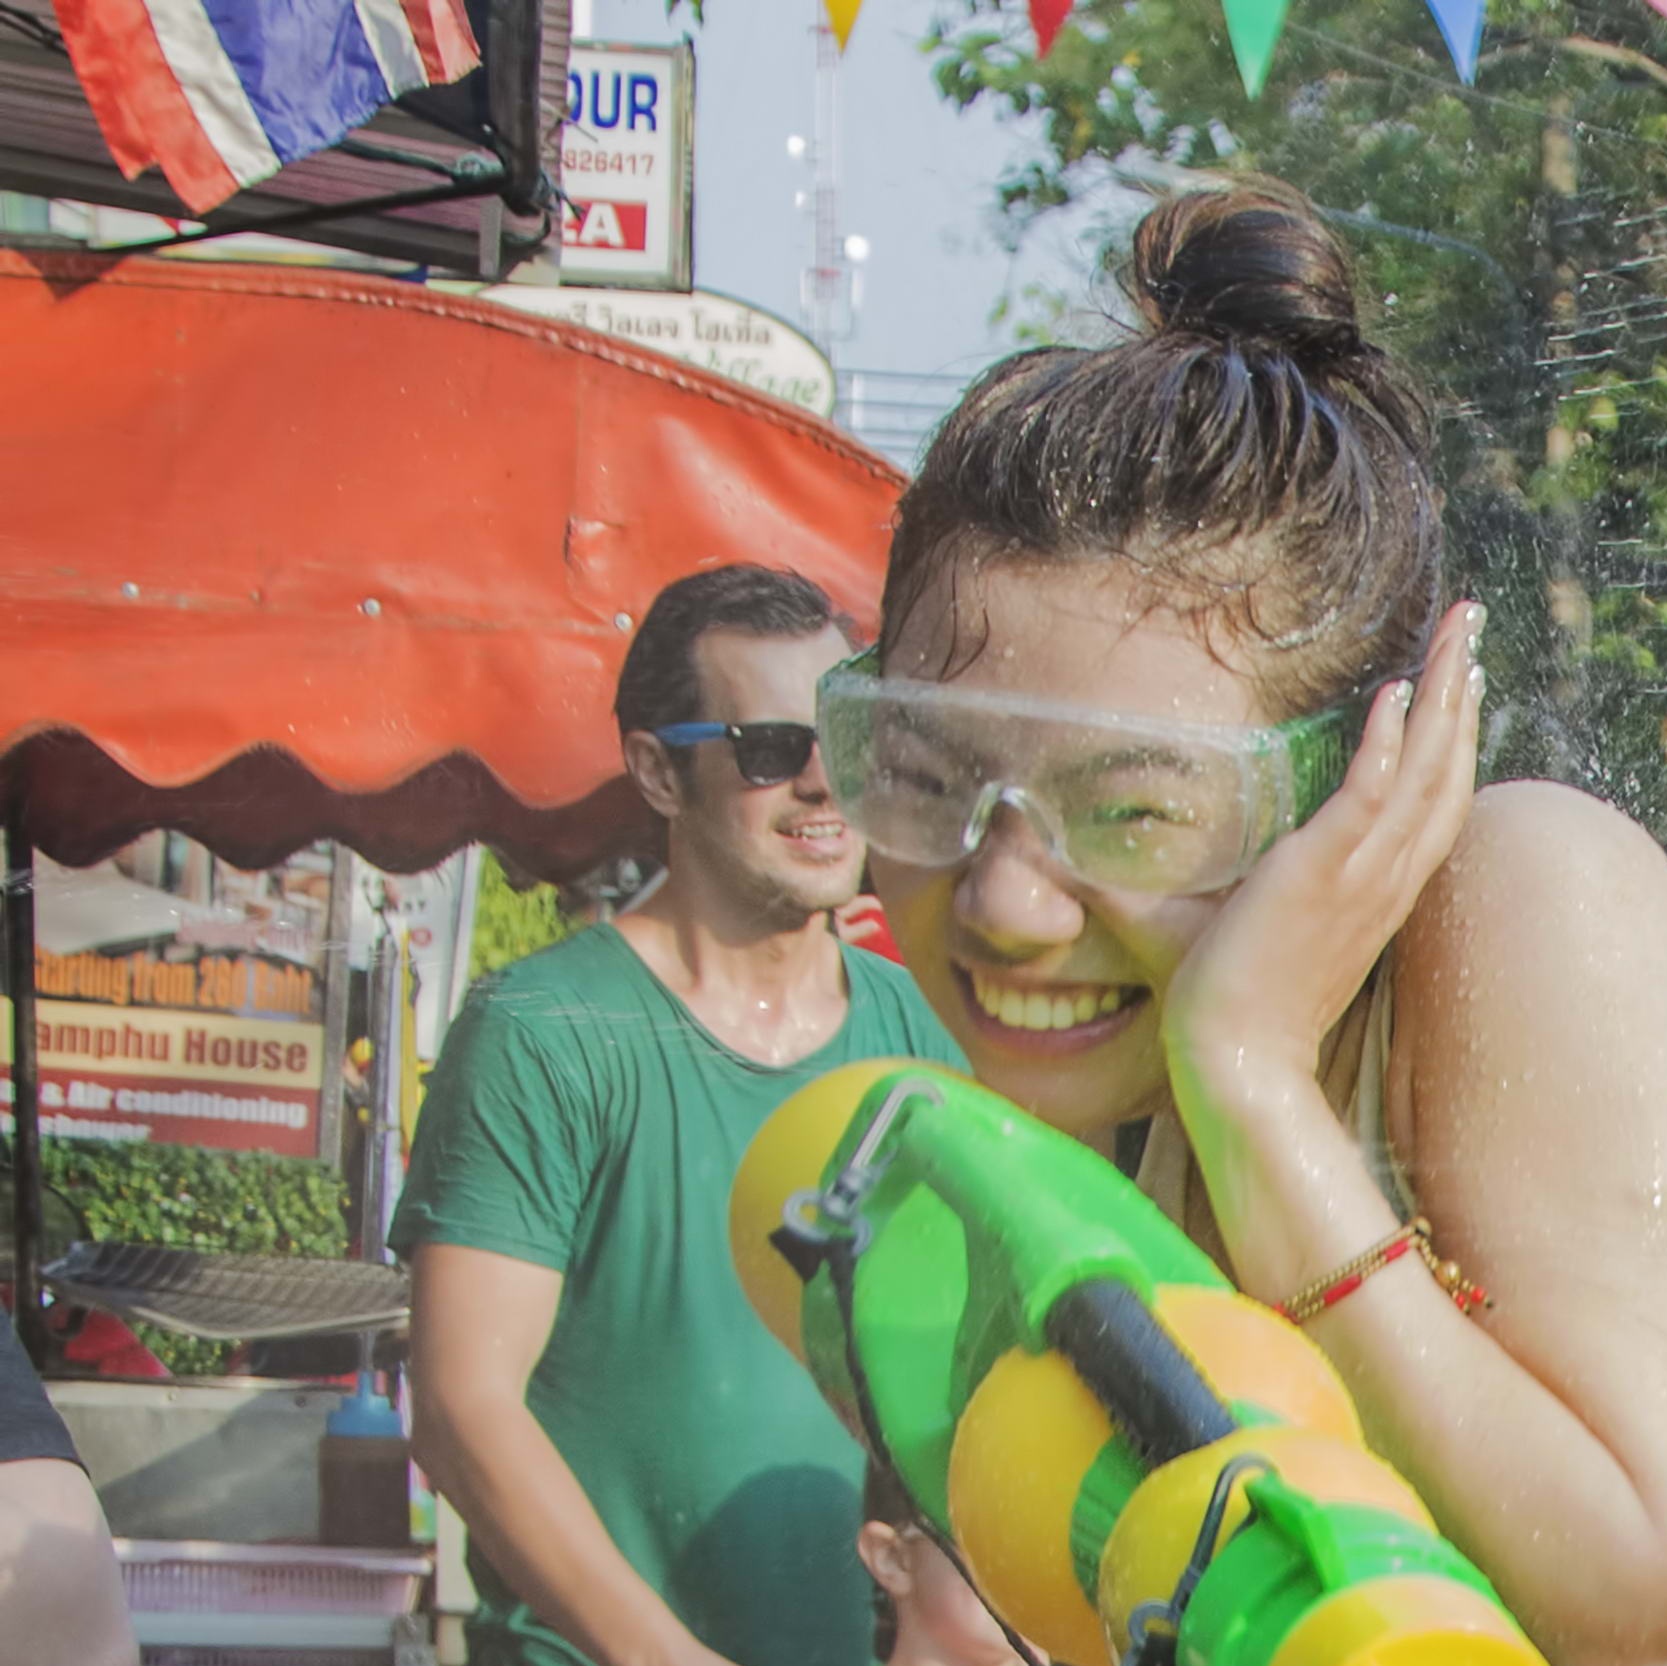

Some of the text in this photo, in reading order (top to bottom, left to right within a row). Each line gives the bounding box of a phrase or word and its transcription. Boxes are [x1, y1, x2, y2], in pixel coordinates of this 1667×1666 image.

[563, 69, 658, 132] OUR
[563, 149, 656, 177] 826417
[36, 1018, 309, 1074] amphu House
[115, 1088, 308, 1130] conditioning
